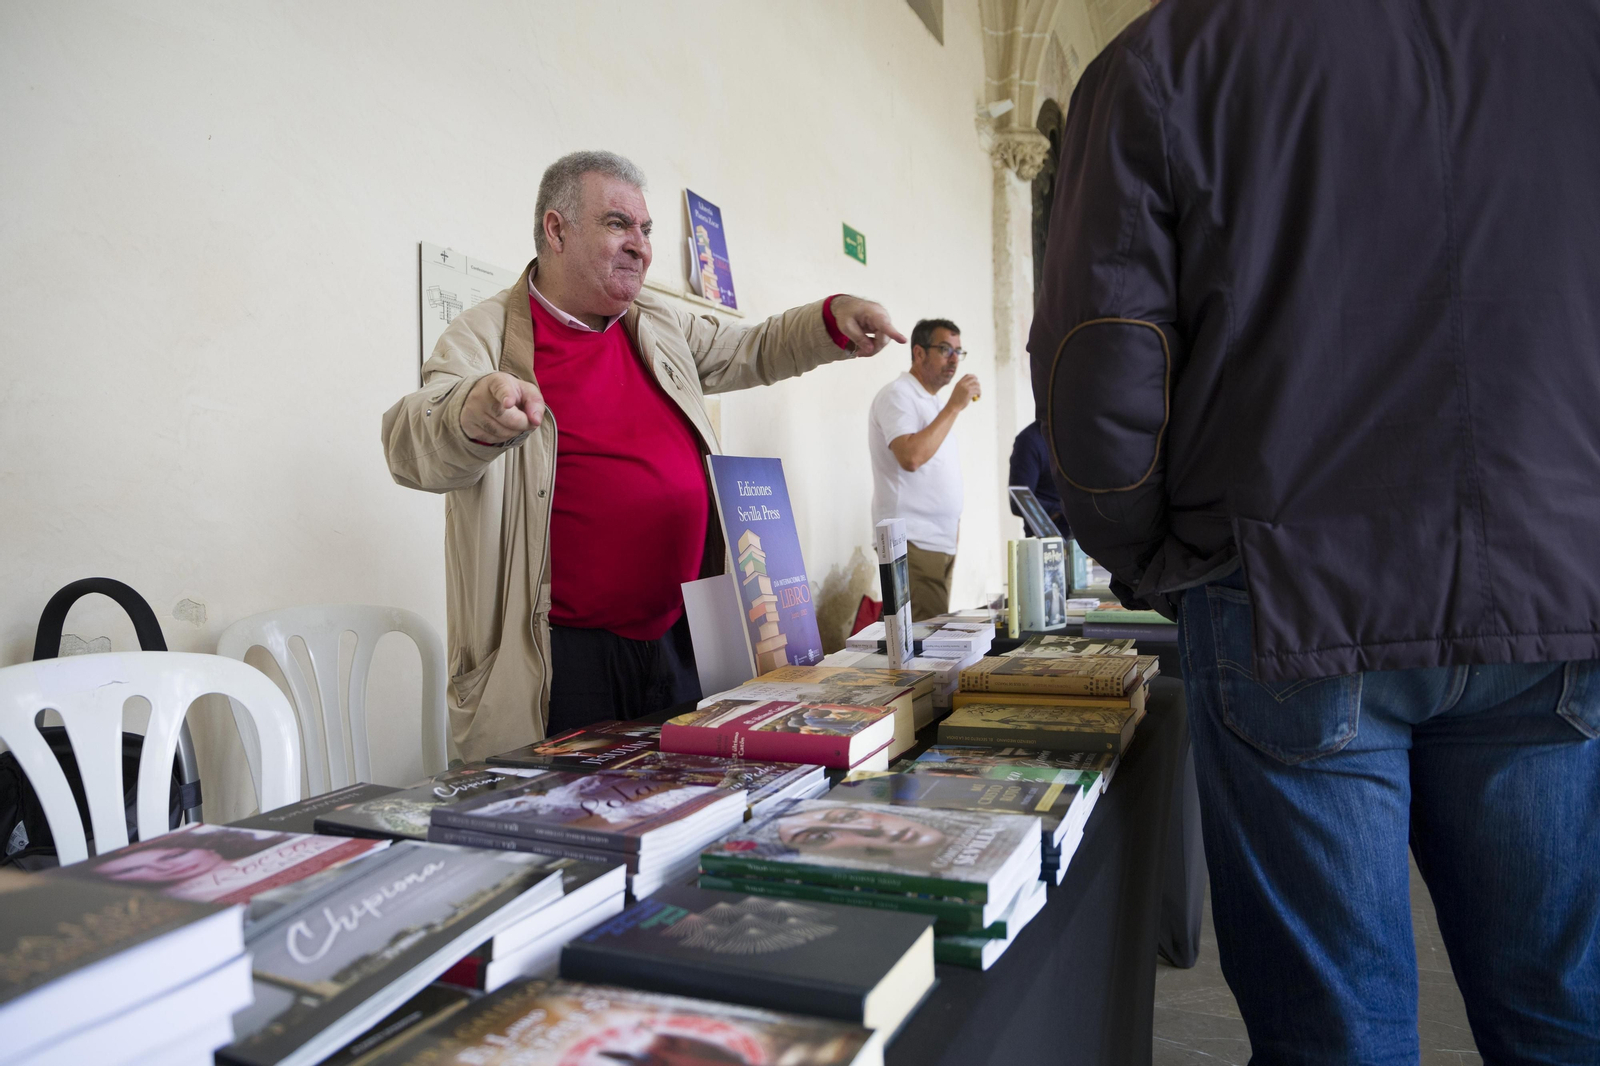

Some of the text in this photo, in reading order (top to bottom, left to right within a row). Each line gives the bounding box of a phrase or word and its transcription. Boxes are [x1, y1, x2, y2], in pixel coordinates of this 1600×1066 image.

[737, 481, 773, 498] Ediciones
[737, 504, 781, 522] Sevilla Press
[779, 584, 811, 609] LIBRO
[580, 740, 655, 765] JESULÍN
[732, 731, 740, 753] último
[433, 776, 506, 798] Chipiona
[978, 784, 1004, 805] CRISTO
[1000, 785, 1022, 802] ROTO
[580, 784, 661, 818] Lola
[286, 859, 446, 964] Chipiona
